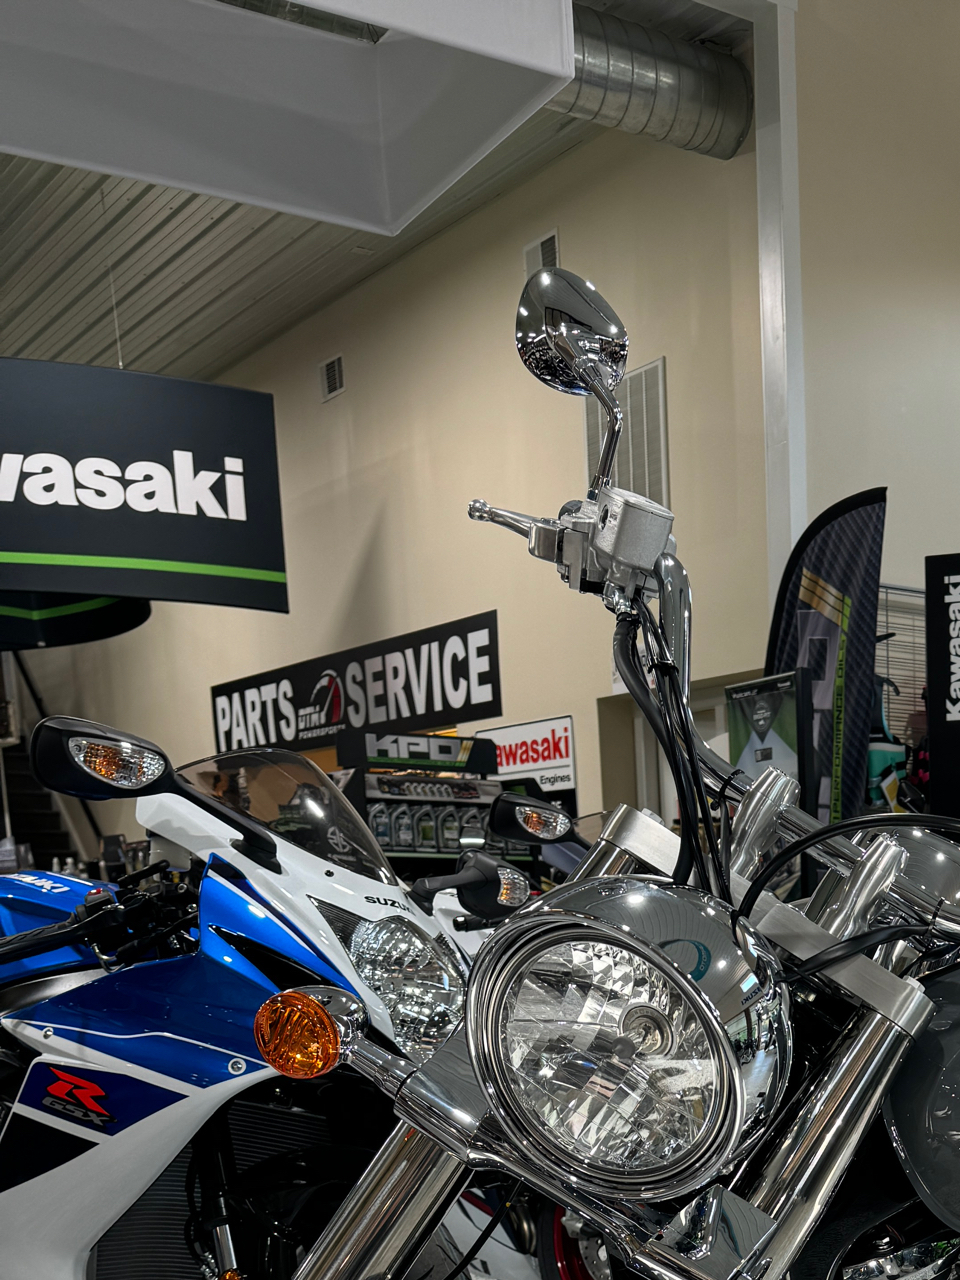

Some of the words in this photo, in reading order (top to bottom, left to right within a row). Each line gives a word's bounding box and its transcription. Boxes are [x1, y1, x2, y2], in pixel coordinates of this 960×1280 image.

[0, 449, 247, 521] asaki
[215, 678, 296, 751] PARTS
[345, 628, 493, 728] SERVICE
[496, 726, 570, 768] awasaki
[540, 773, 571, 786] Engines
[41, 1096, 111, 1127] GSX
[46, 1066, 111, 1117] R
